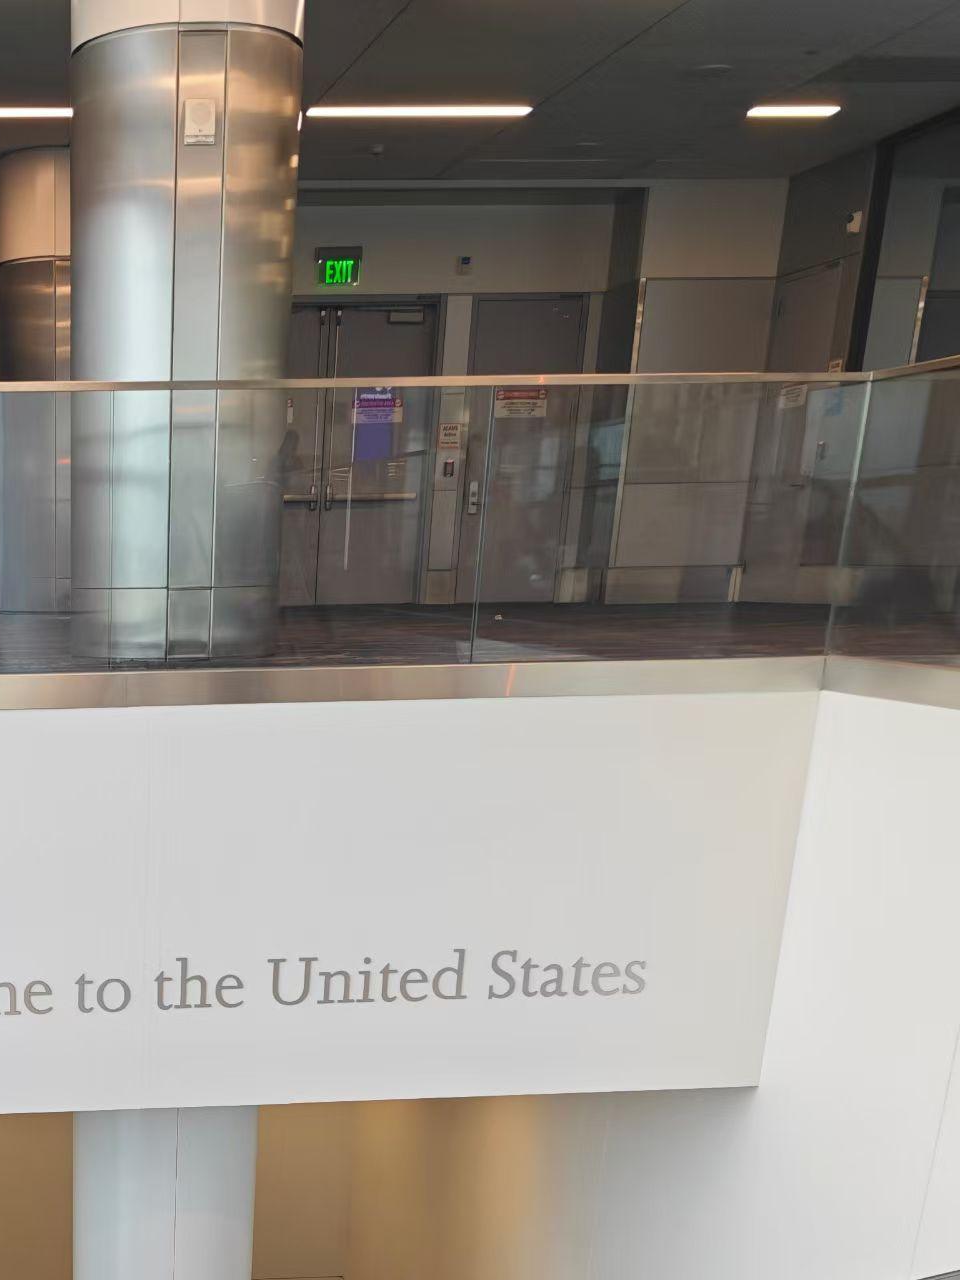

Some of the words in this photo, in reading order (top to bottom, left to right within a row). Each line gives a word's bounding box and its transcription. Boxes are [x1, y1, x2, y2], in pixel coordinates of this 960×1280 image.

[326, 260, 354, 284] EXIT
[74, 972, 132, 1013] to
[153, 957, 244, 1010] the
[267, 948, 467, 1005] United
[487, 949, 646, 1000] States
